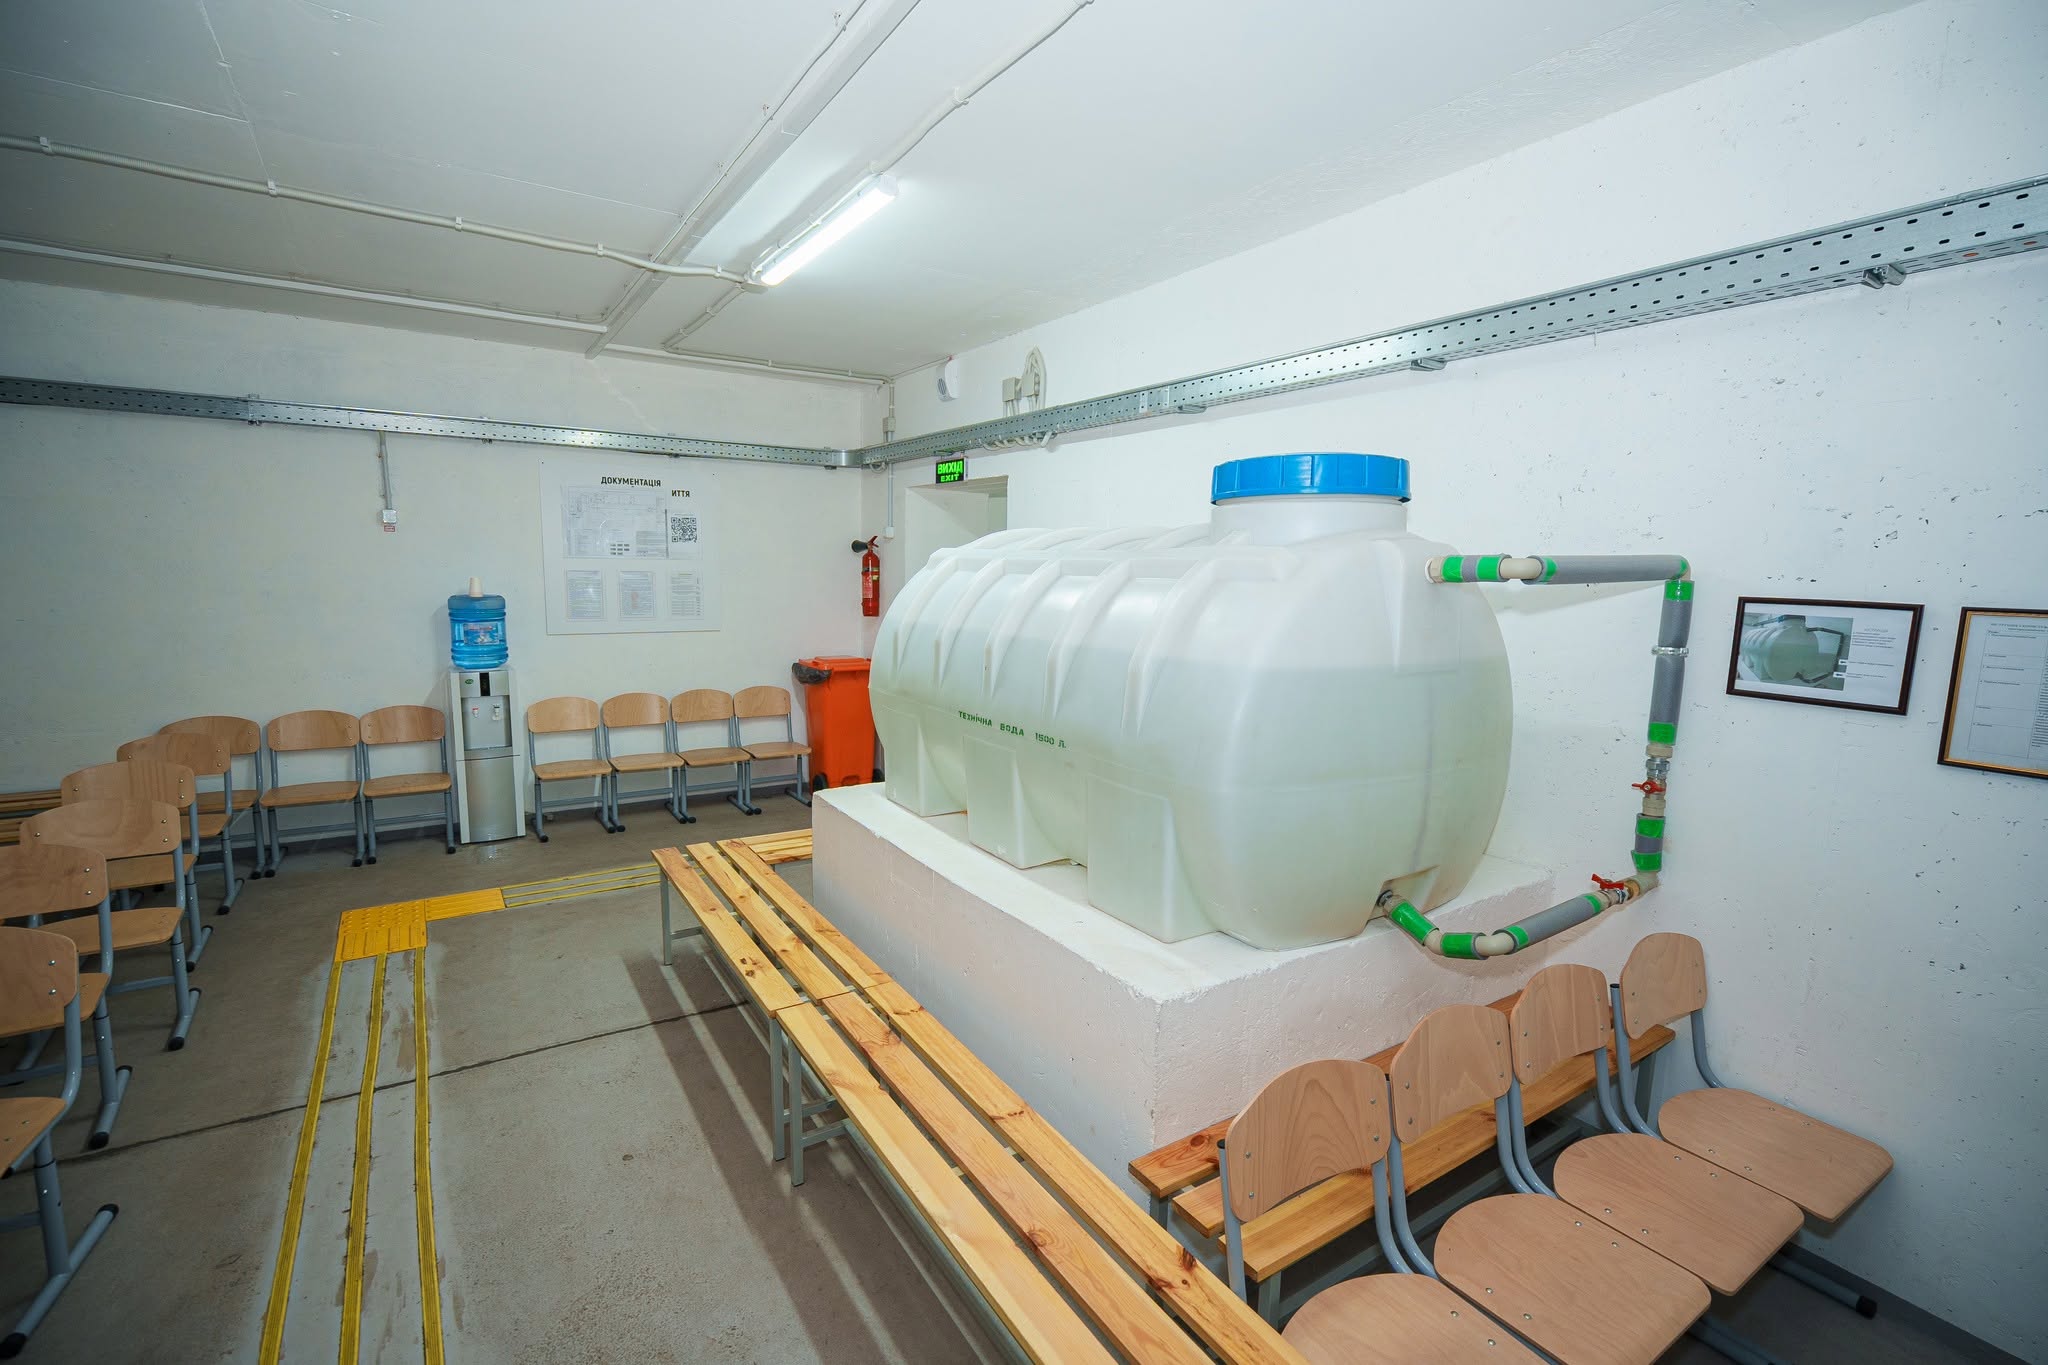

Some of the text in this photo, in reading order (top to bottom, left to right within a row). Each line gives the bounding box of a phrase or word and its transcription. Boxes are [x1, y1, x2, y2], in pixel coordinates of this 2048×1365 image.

[937, 460, 963, 475] ВИХІД
[600, 476, 661, 487] ДОКУМЕНТАЦІЯ
[940, 474, 959, 483] EXIT
[999, 723, 1025, 737] ВОДА
[1035, 732, 1055, 745] 1500
